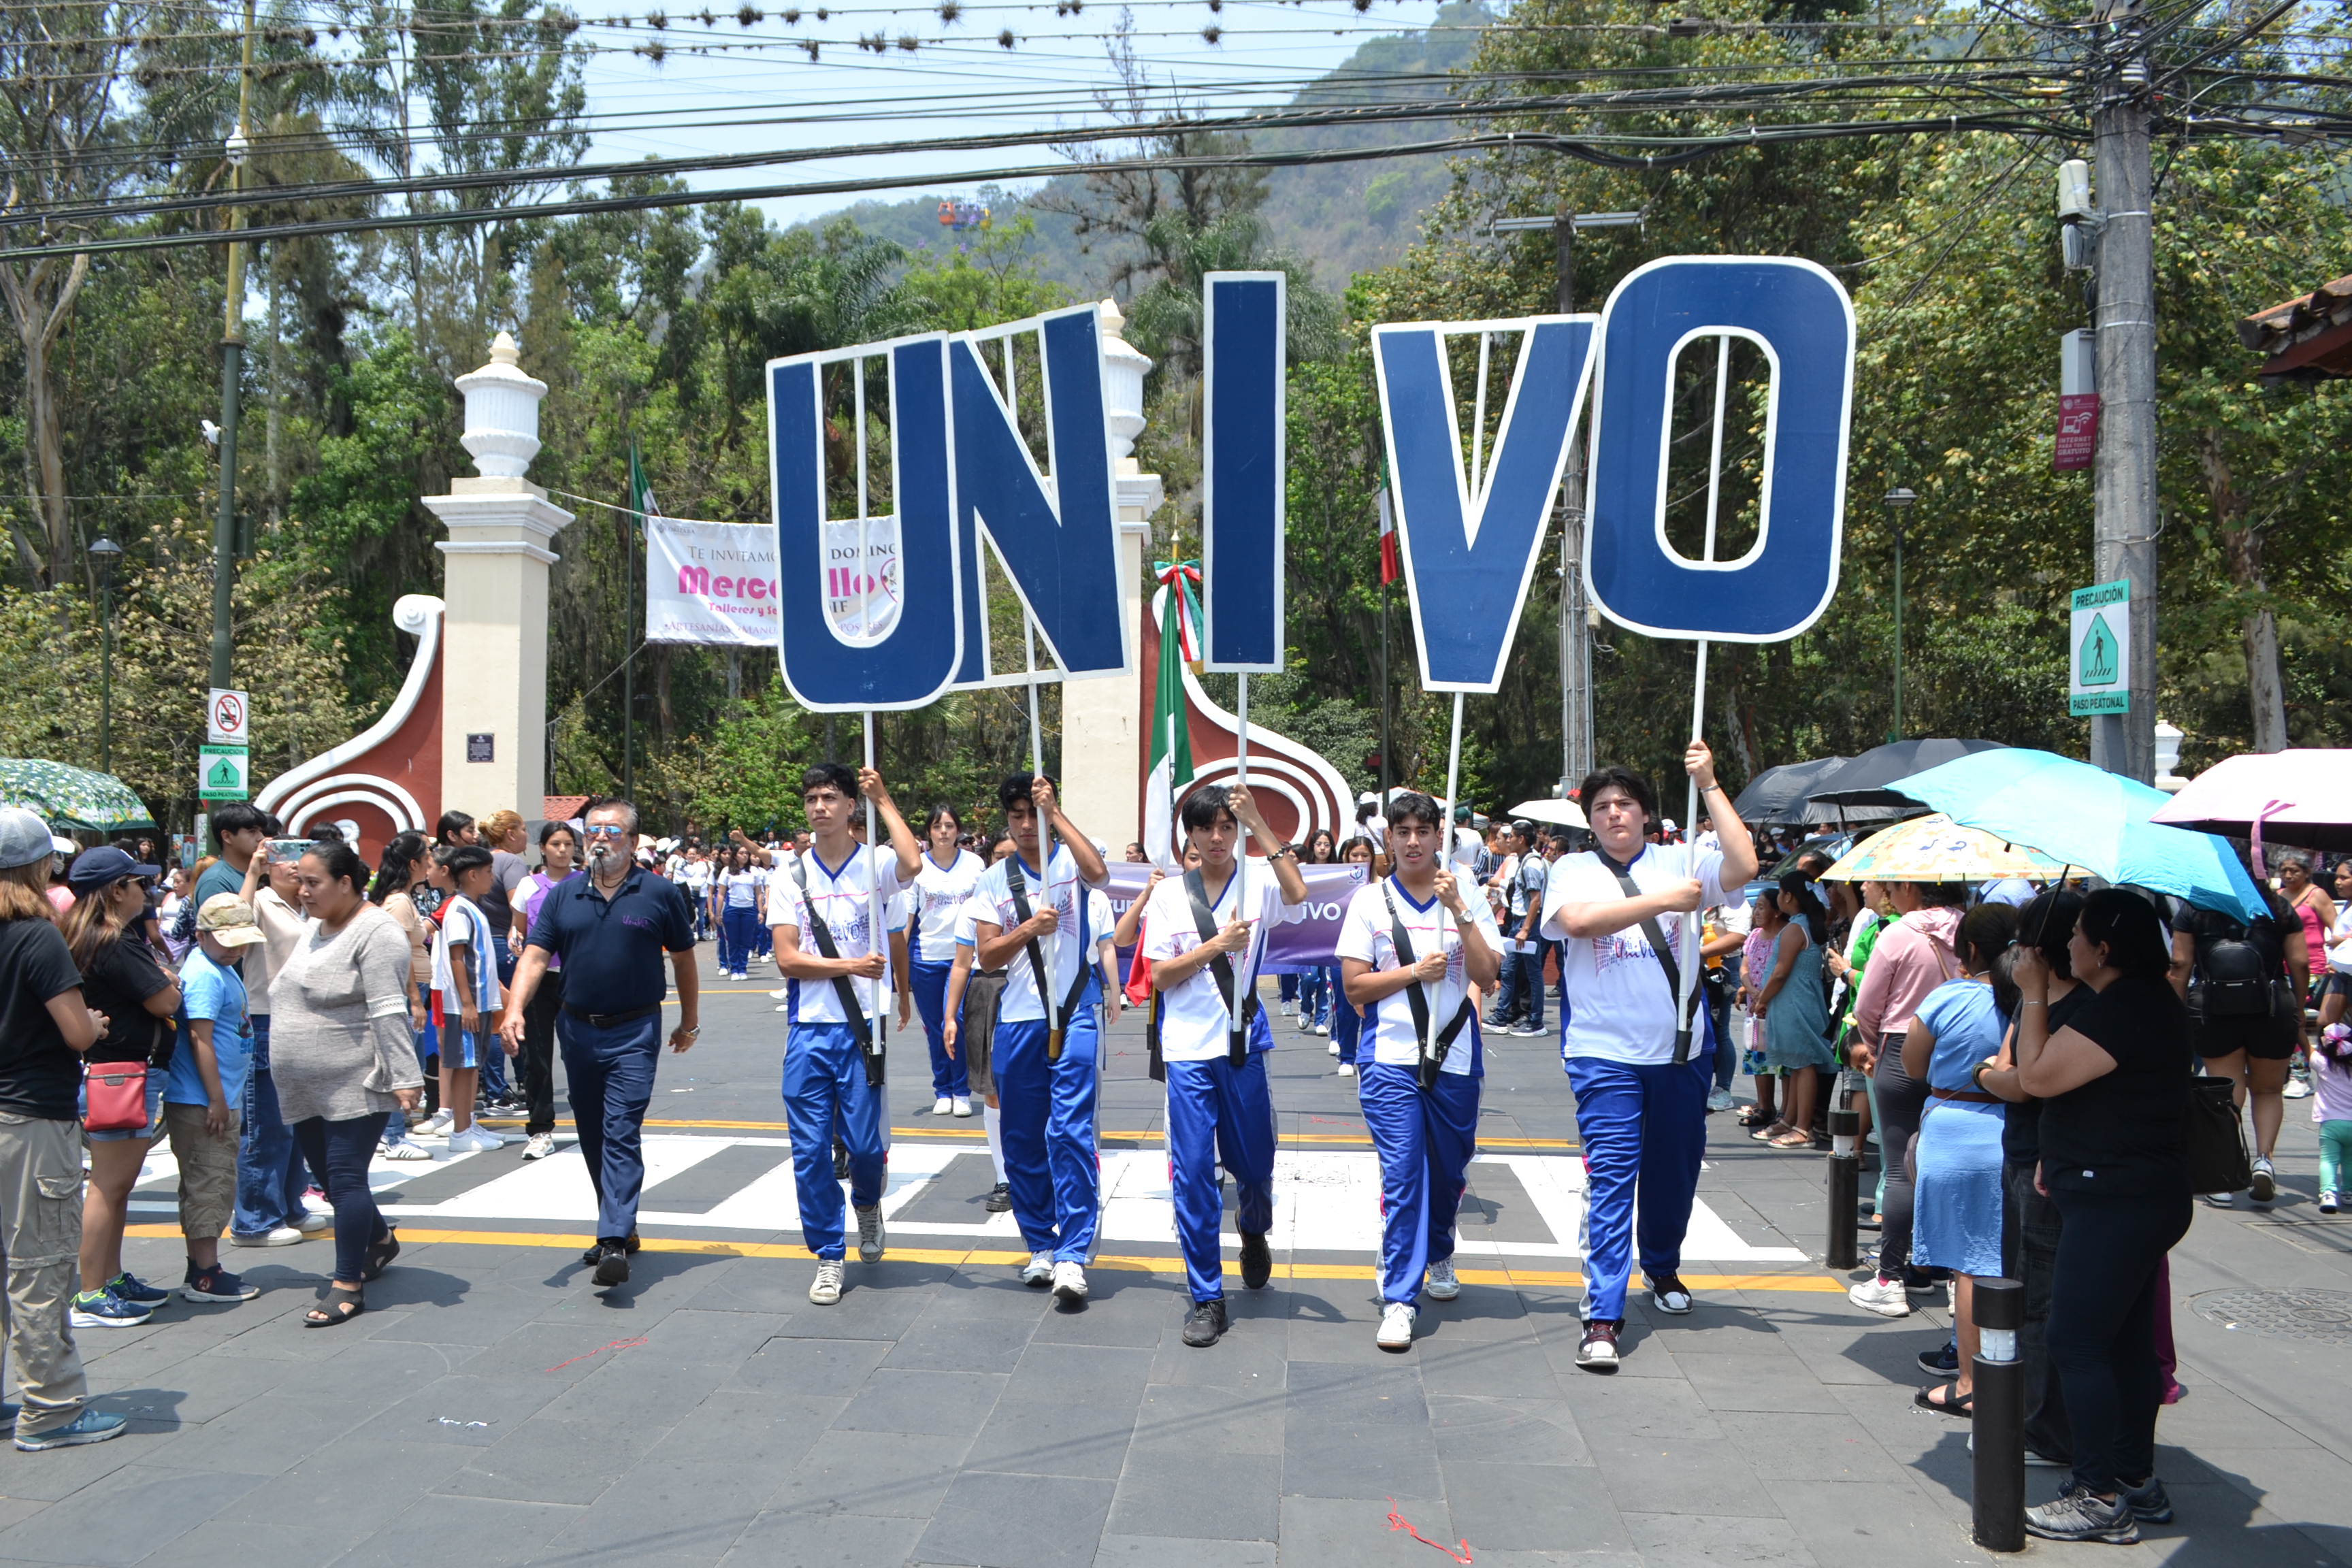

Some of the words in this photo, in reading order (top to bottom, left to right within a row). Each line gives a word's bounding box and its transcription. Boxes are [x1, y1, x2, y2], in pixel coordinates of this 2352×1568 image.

[687, 546, 704, 559] TE
[2076, 585, 2123, 608] PRECAUCIÓN
[708, 603, 754, 615] Talleres
[758, 608, 764, 617] y
[841, 619, 883, 633] POSRES
[2073, 698, 2089, 710] PASO
[2090, 696, 2125, 709] PEATONAL
[204, 747, 244, 755] PRECAUCIÓN
